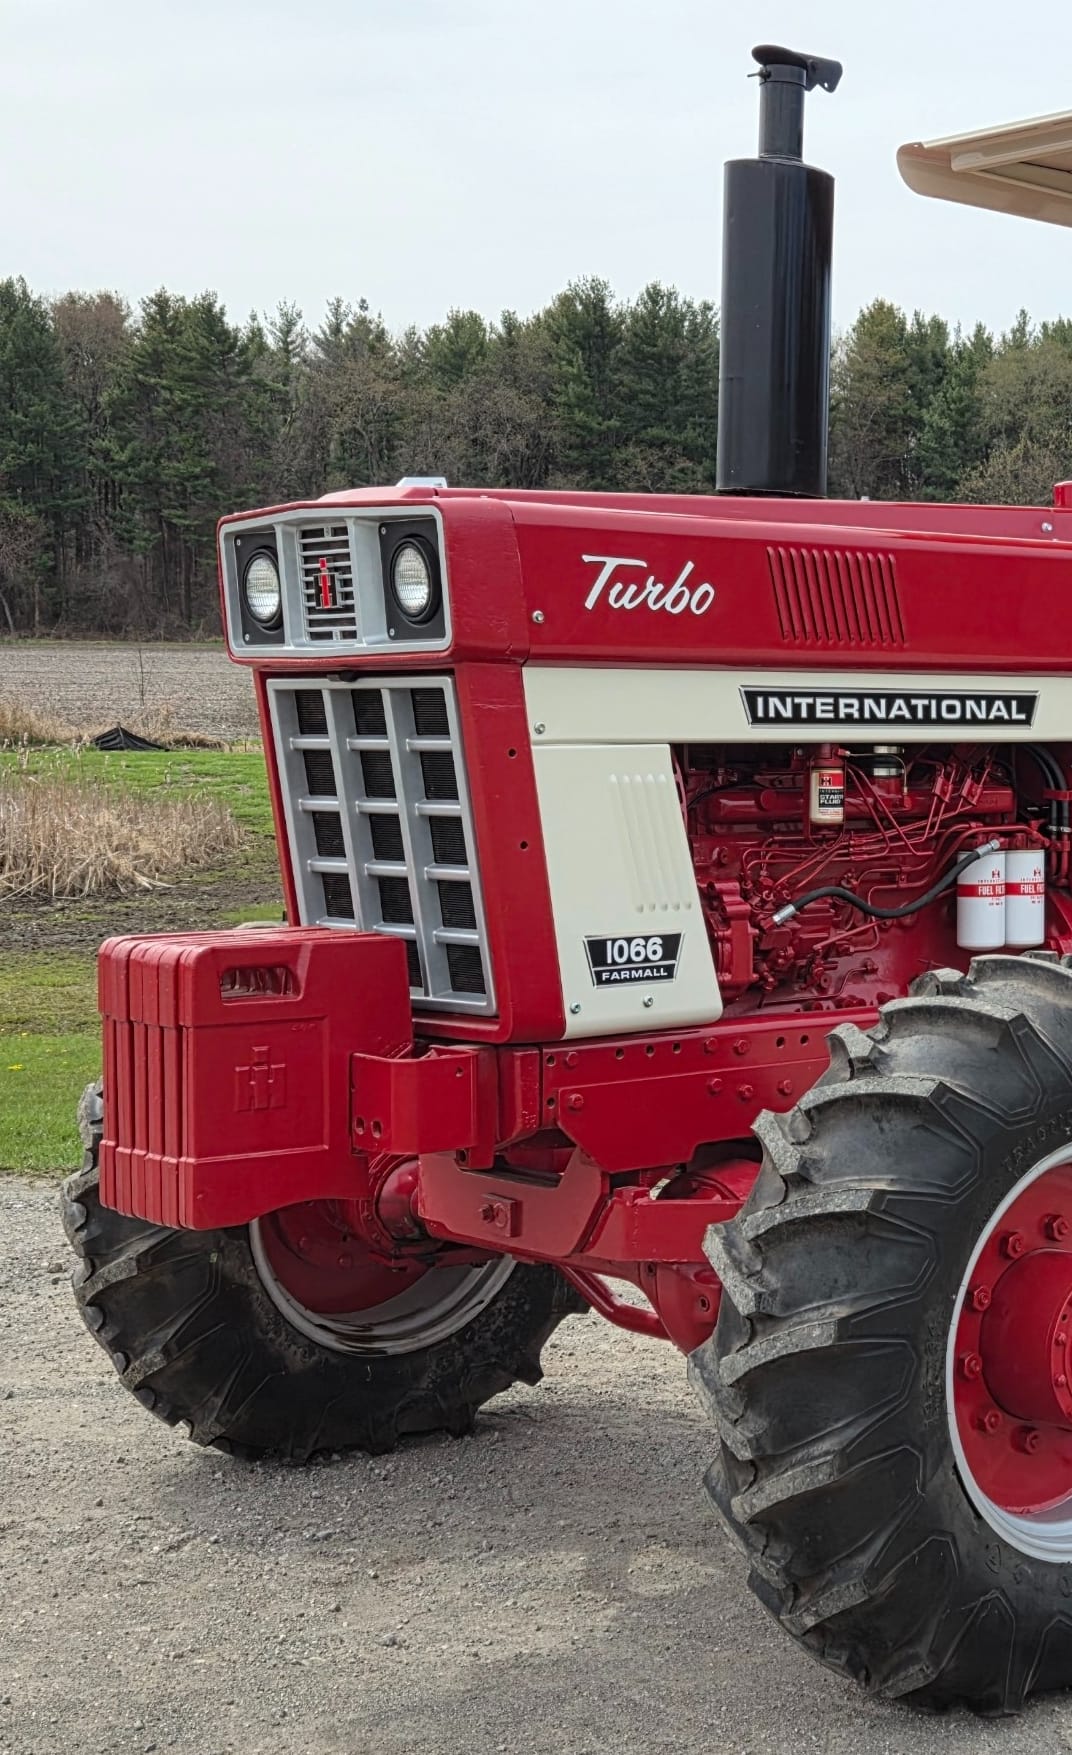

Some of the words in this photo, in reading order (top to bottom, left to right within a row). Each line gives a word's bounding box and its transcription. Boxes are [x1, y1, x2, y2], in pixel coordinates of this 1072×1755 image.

[581, 554, 715, 615] Turbo
[756, 696, 1027, 720] INTERNATIONAL
[978, 885, 994, 896] FUEL
[1020, 883, 1035, 894] FUEL
[606, 936, 663, 964] 1066
[602, 967, 668, 981] FARMALL
